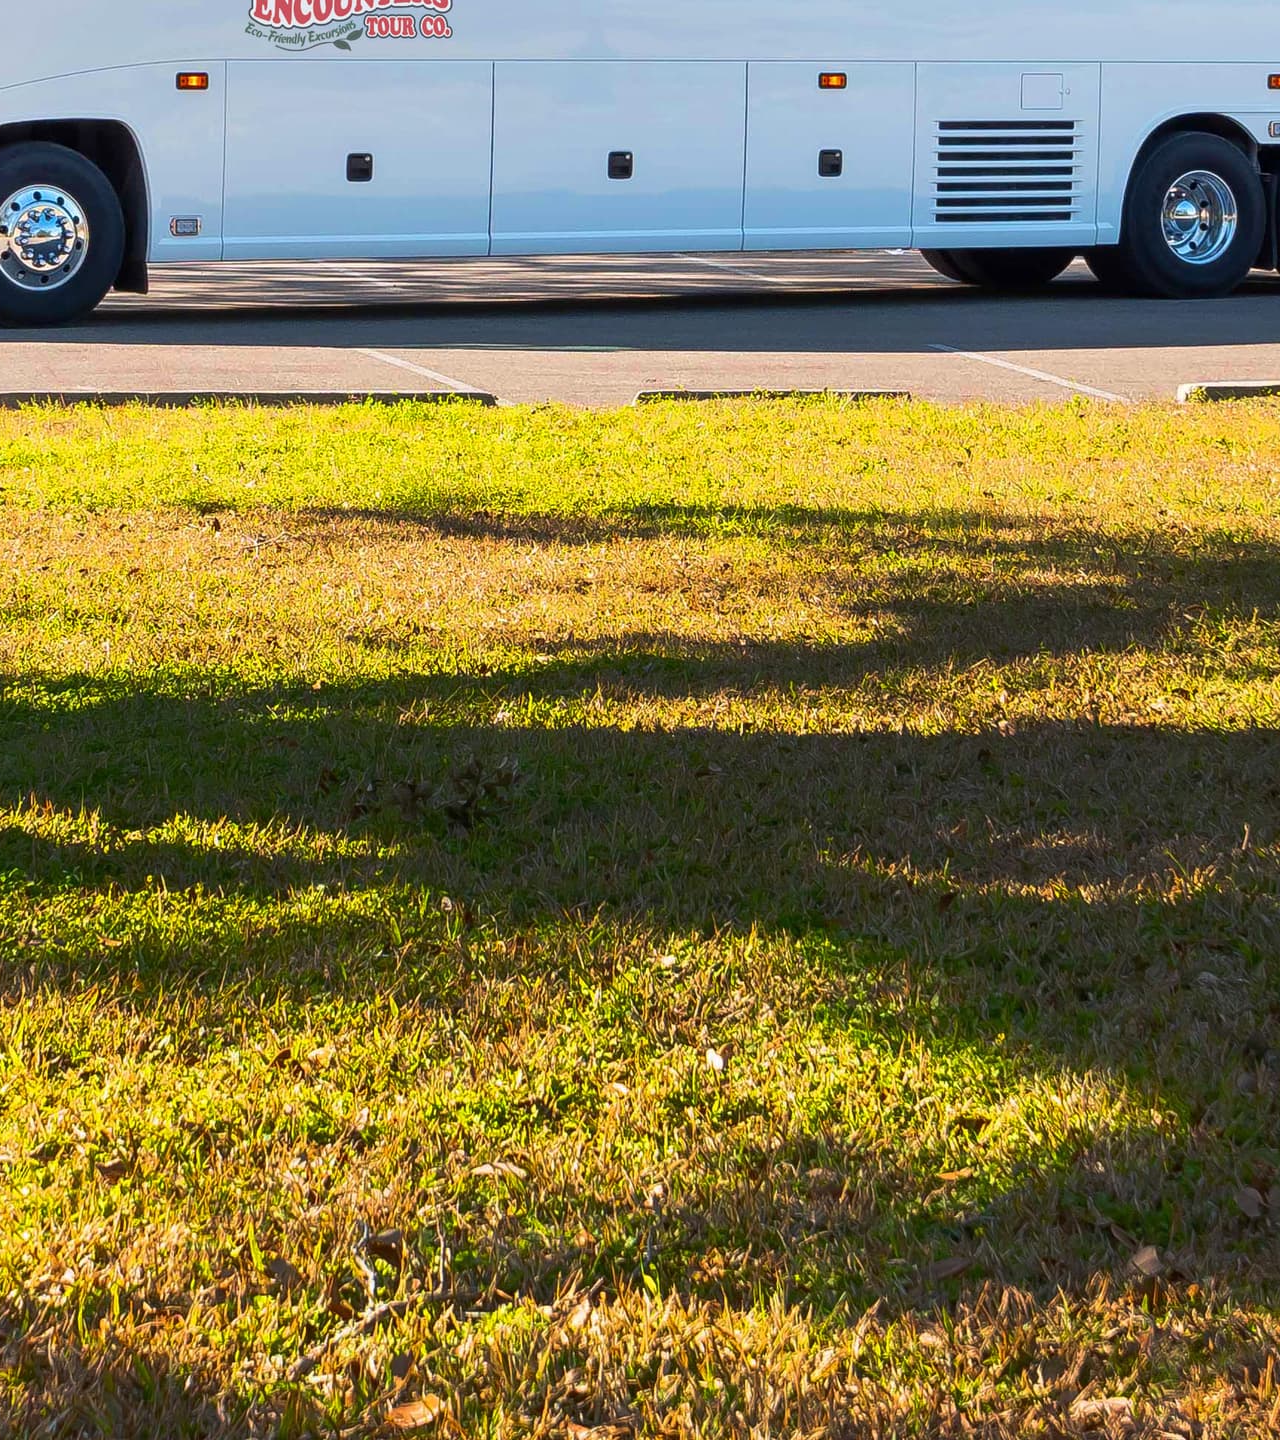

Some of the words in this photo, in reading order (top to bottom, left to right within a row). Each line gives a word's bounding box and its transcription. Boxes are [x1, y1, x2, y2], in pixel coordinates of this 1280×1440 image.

[244, 22, 306, 47] Eco-Friendly
[308, 20, 356, 44] Excursions
[365, 16, 415, 36] TOUR
[421, 16, 451, 36] CO.
